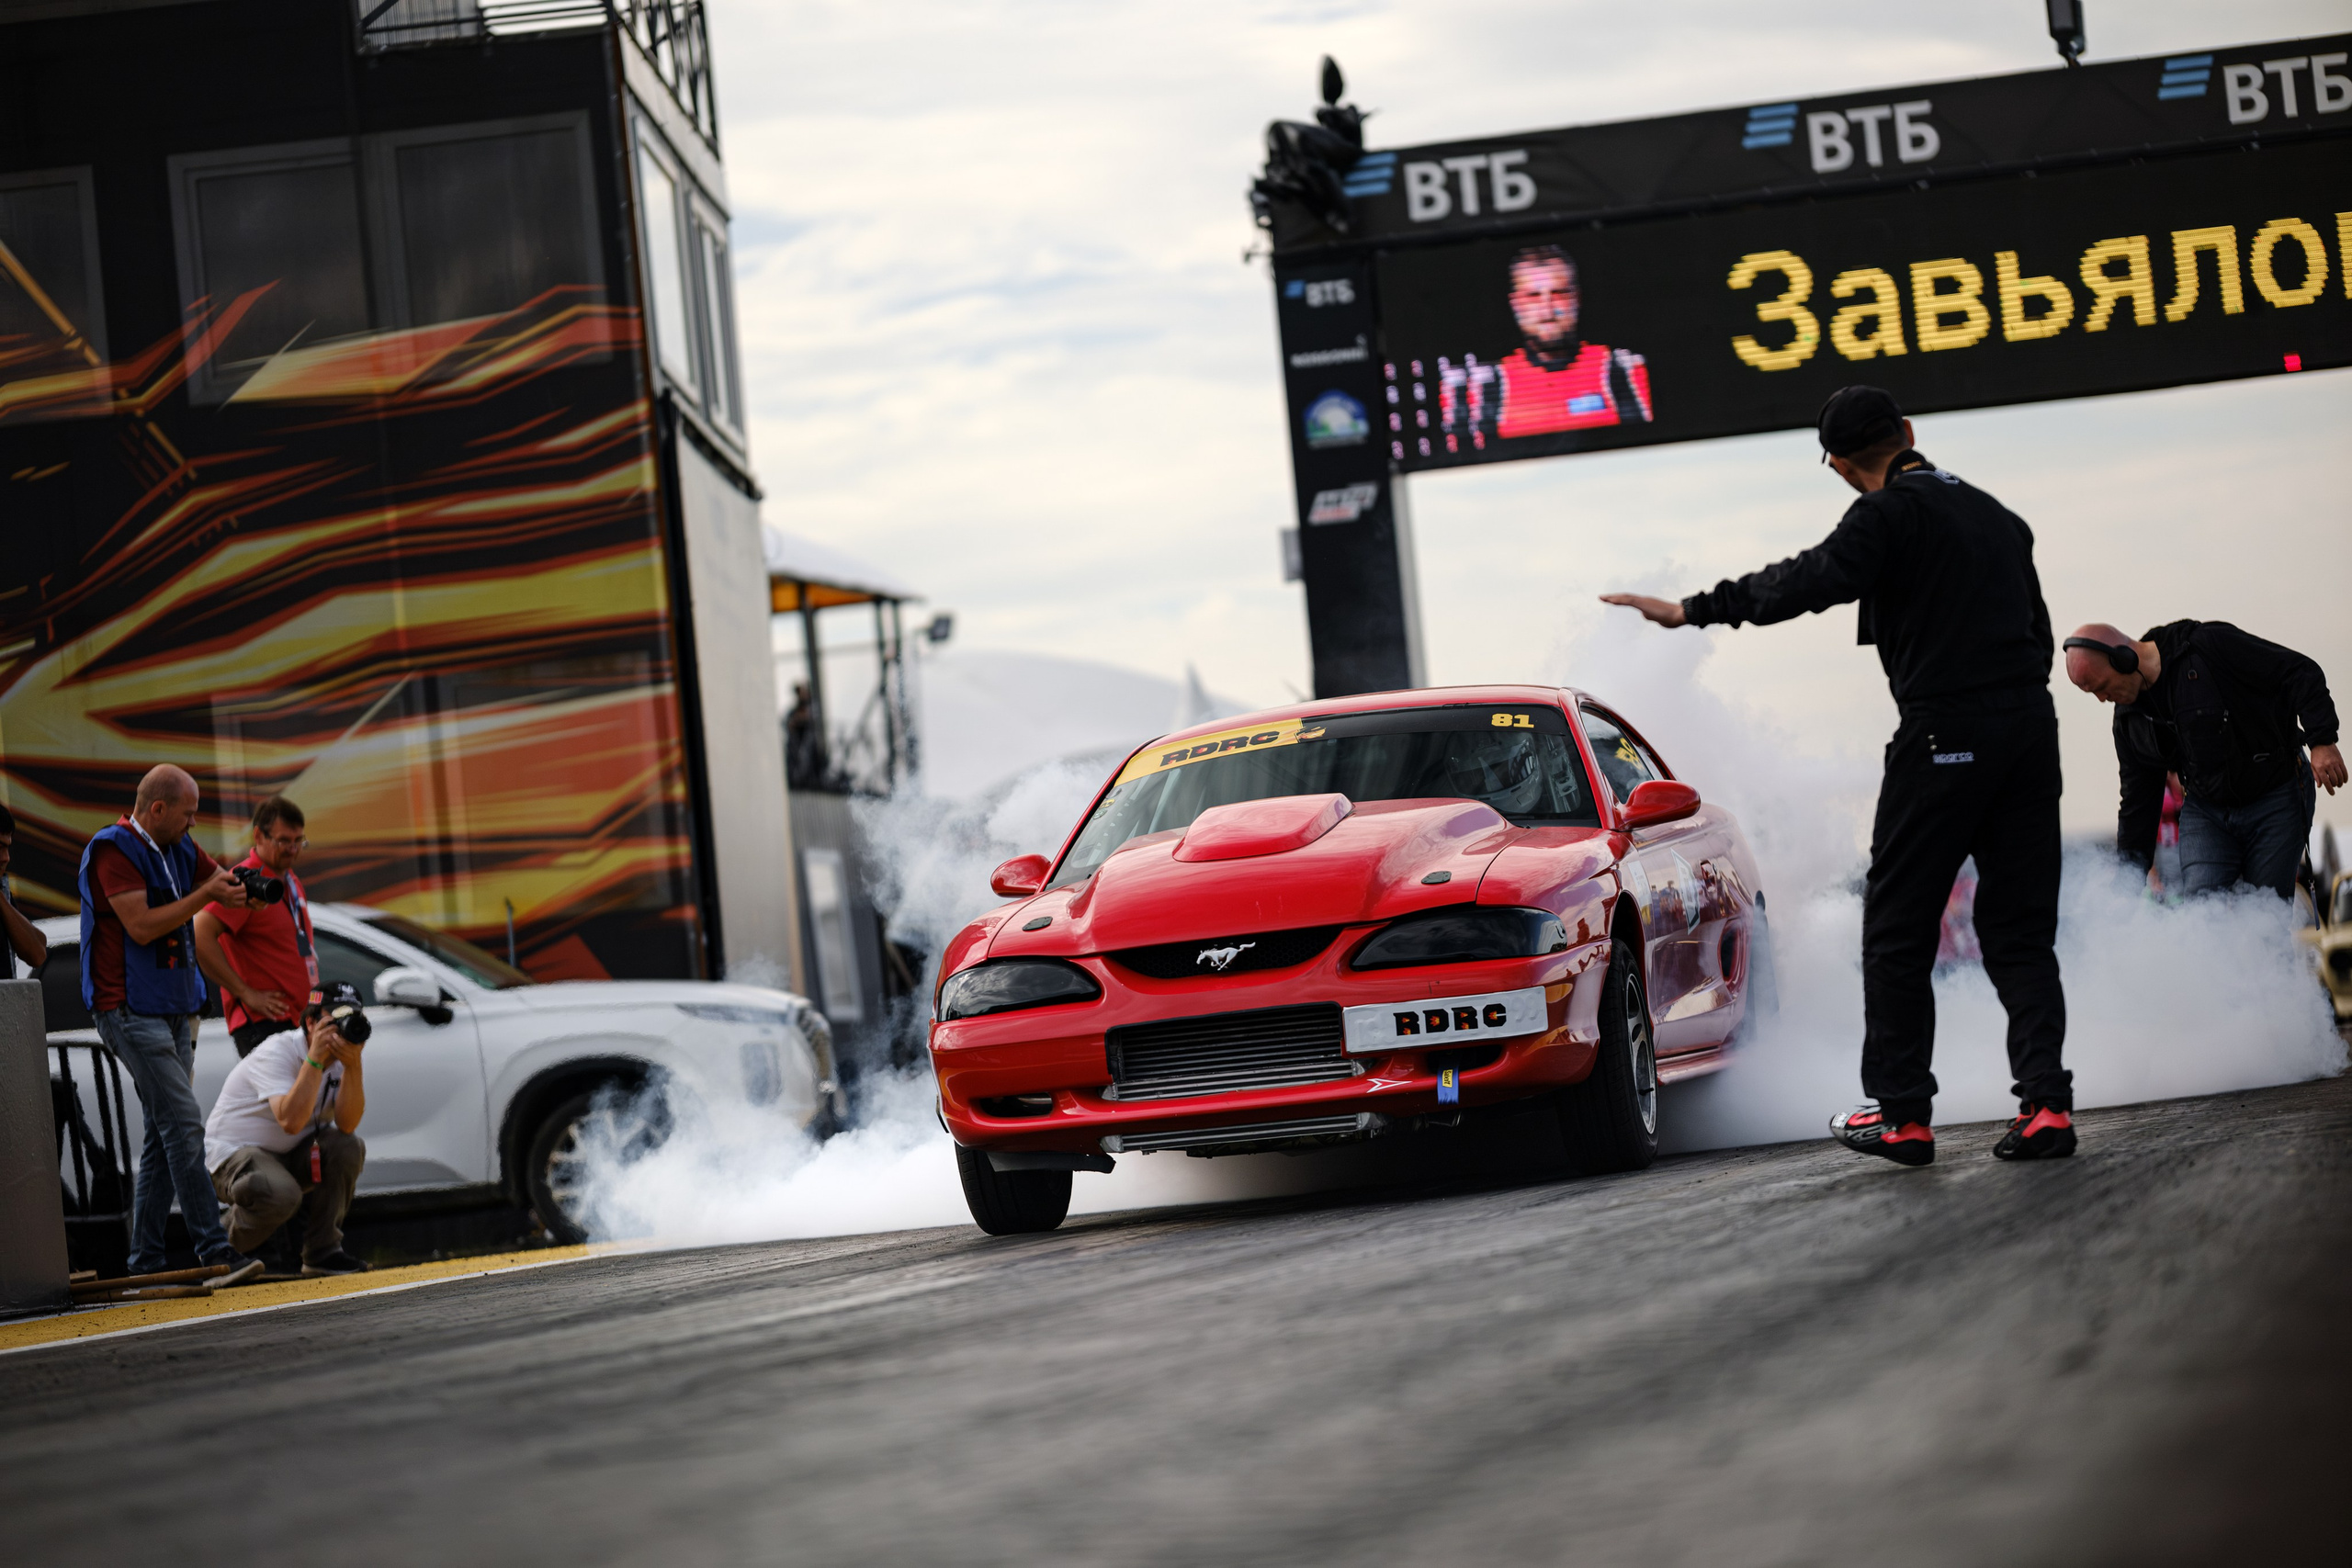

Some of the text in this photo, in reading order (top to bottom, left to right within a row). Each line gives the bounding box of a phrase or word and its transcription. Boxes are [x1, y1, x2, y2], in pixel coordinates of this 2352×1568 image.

[2222, 52, 2352, 125] ВТБ
[1806, 101, 1940, 173] ВТБ
[1404, 151, 1537, 222] ВТБ
[1306, 278, 1355, 307] ВТБ
[1727, 212, 2352, 371] Завьяло
[1491, 713, 1534, 728] 81
[1159, 731, 1281, 766] RDRC
[1393, 1003, 1507, 1036] RDRC
